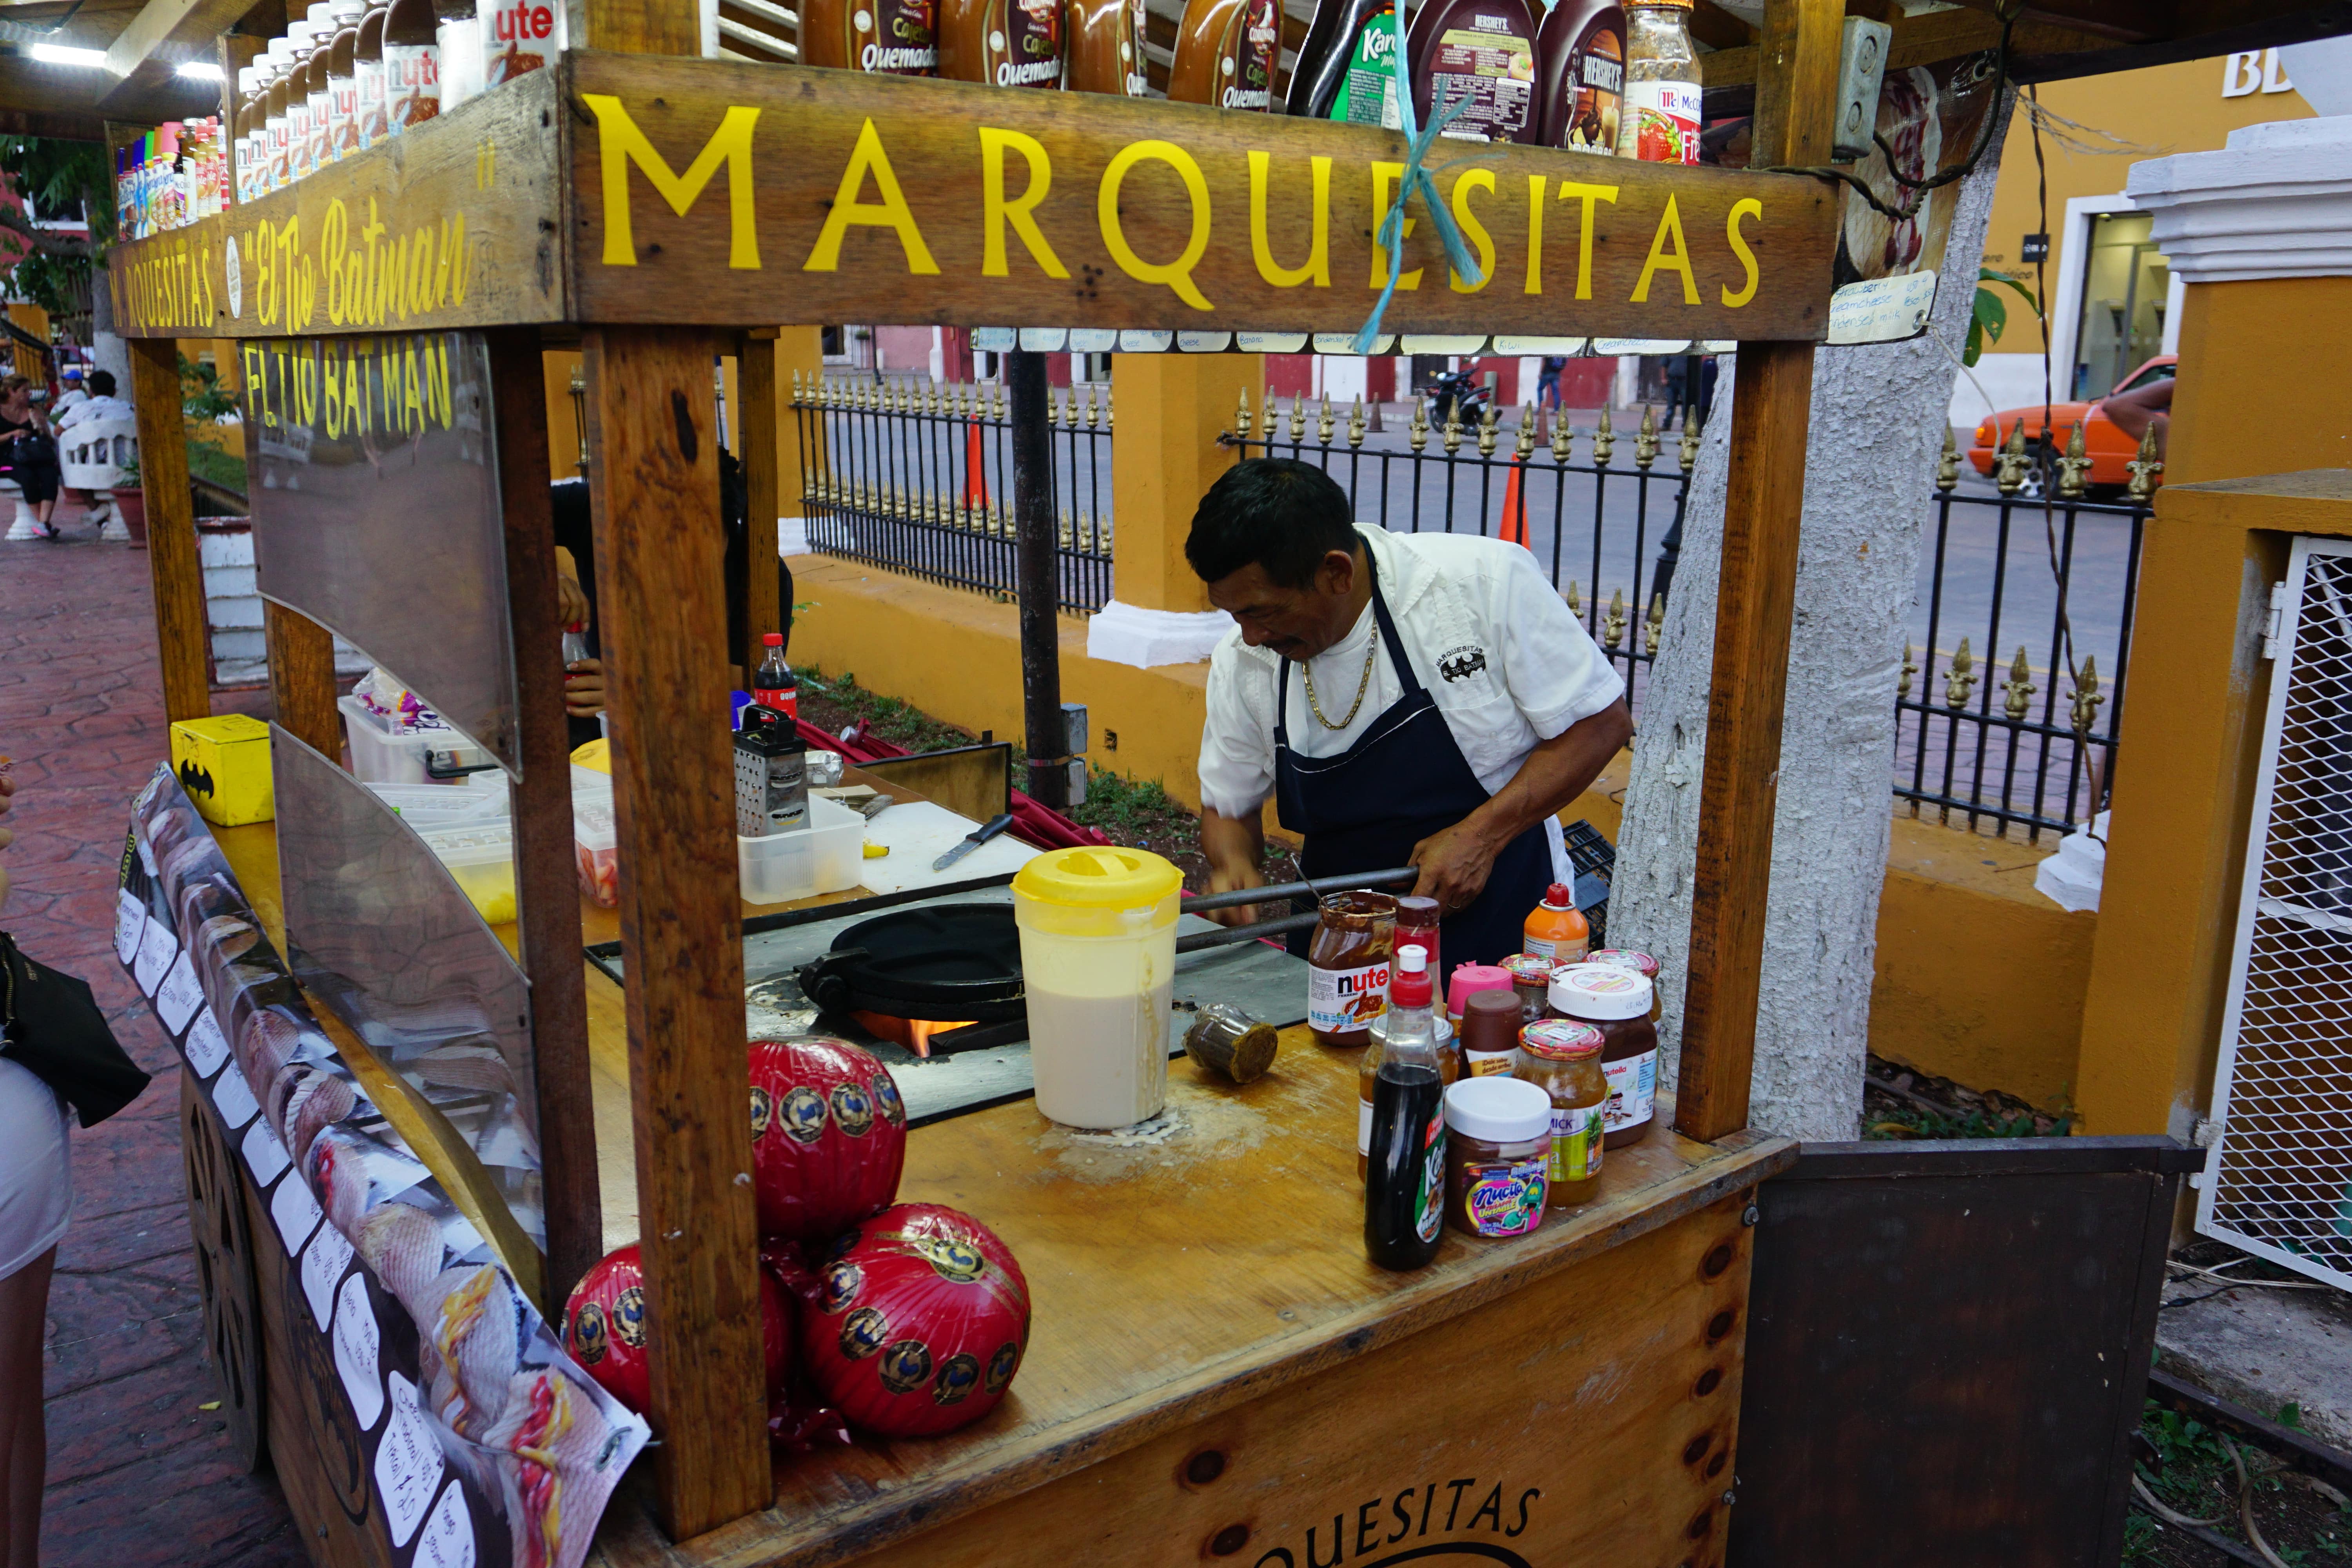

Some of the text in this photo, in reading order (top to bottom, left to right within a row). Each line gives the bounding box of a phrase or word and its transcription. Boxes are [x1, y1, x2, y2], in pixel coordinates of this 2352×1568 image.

[1475, 14, 1509, 30] HERSHEY'S
[1249, 26, 1276, 44] CORONADO
[1583, 55, 1622, 93] HERSHEY'S
[581, 93, 1762, 312] MARQUESITAS
[109, 248, 213, 338] MRQUESITAS
[1833, 280, 1889, 301] Strawberry
[1179, 338, 1200, 347] Cheese
[1436, 646, 1483, 668] MARQUESITAS
[1464, 658, 1484, 671] BATMAN
[1482, 1065, 1497, 1074] desde
[1479, 1199, 1516, 1219] UNTABLE
